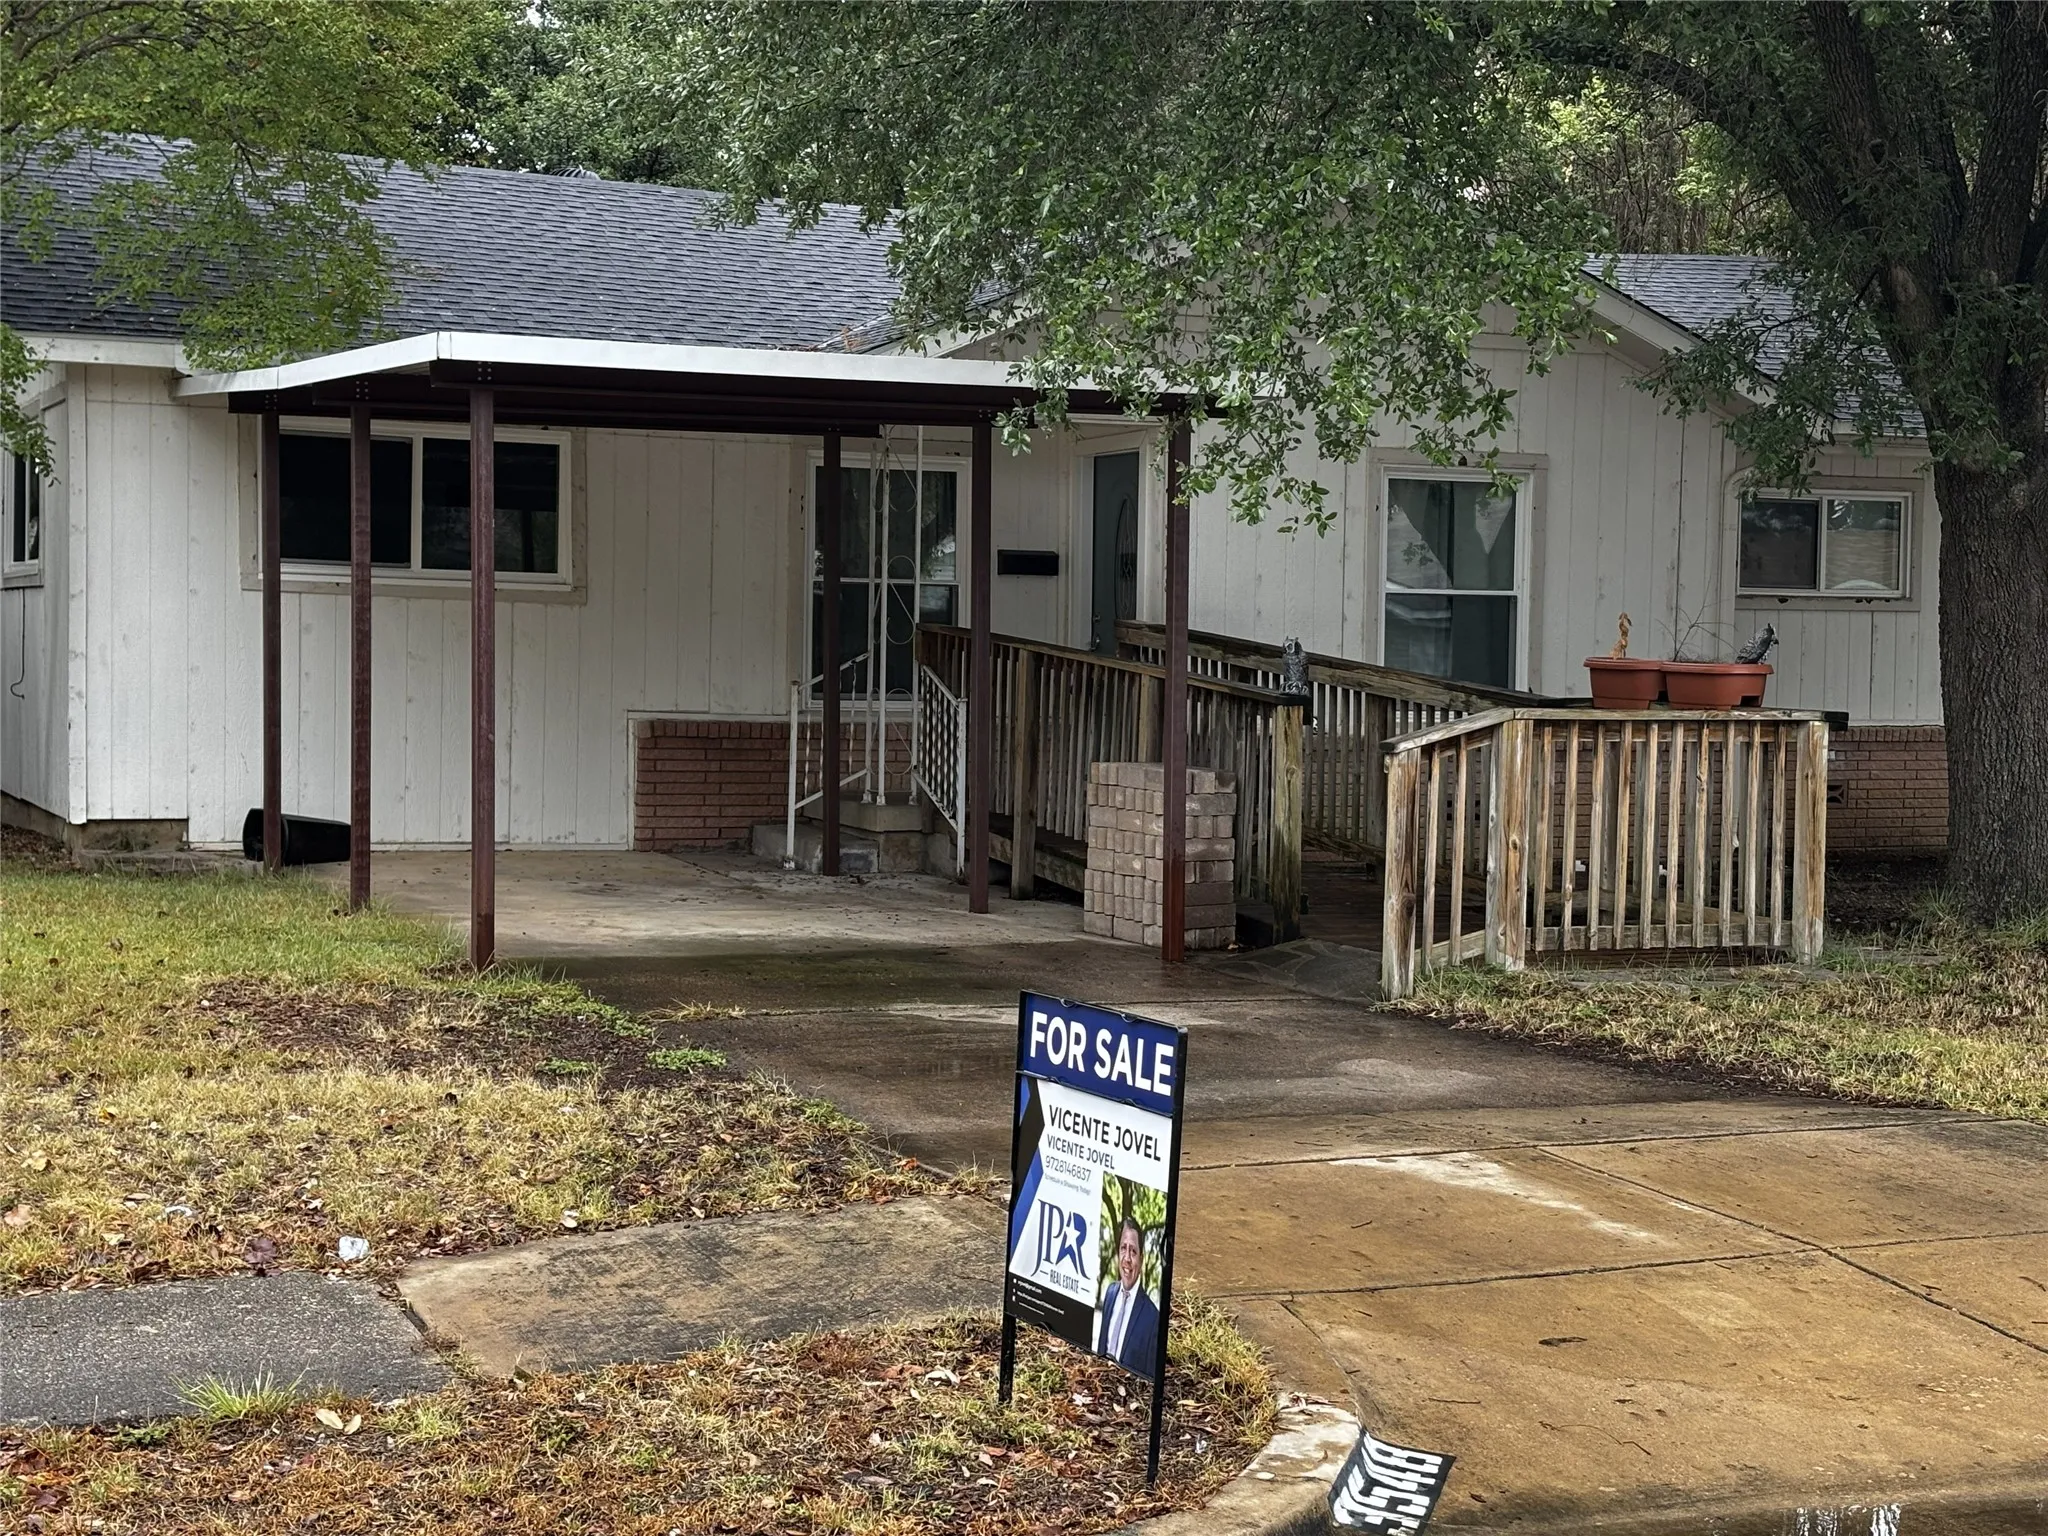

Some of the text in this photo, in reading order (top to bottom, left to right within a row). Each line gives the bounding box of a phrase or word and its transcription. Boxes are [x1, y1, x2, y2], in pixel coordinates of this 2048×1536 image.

[1029, 1011, 1174, 1097] FOR SALE
[1049, 1104, 1161, 1162] VICENTE JOVEL
[1045, 1155, 1092, 1182] 9728146837
[1047, 1134, 1115, 1170] VICENTE JOVEL
[1050, 1269, 1062, 1287] REAL
[1062, 1274, 1079, 1294] ESTATE
